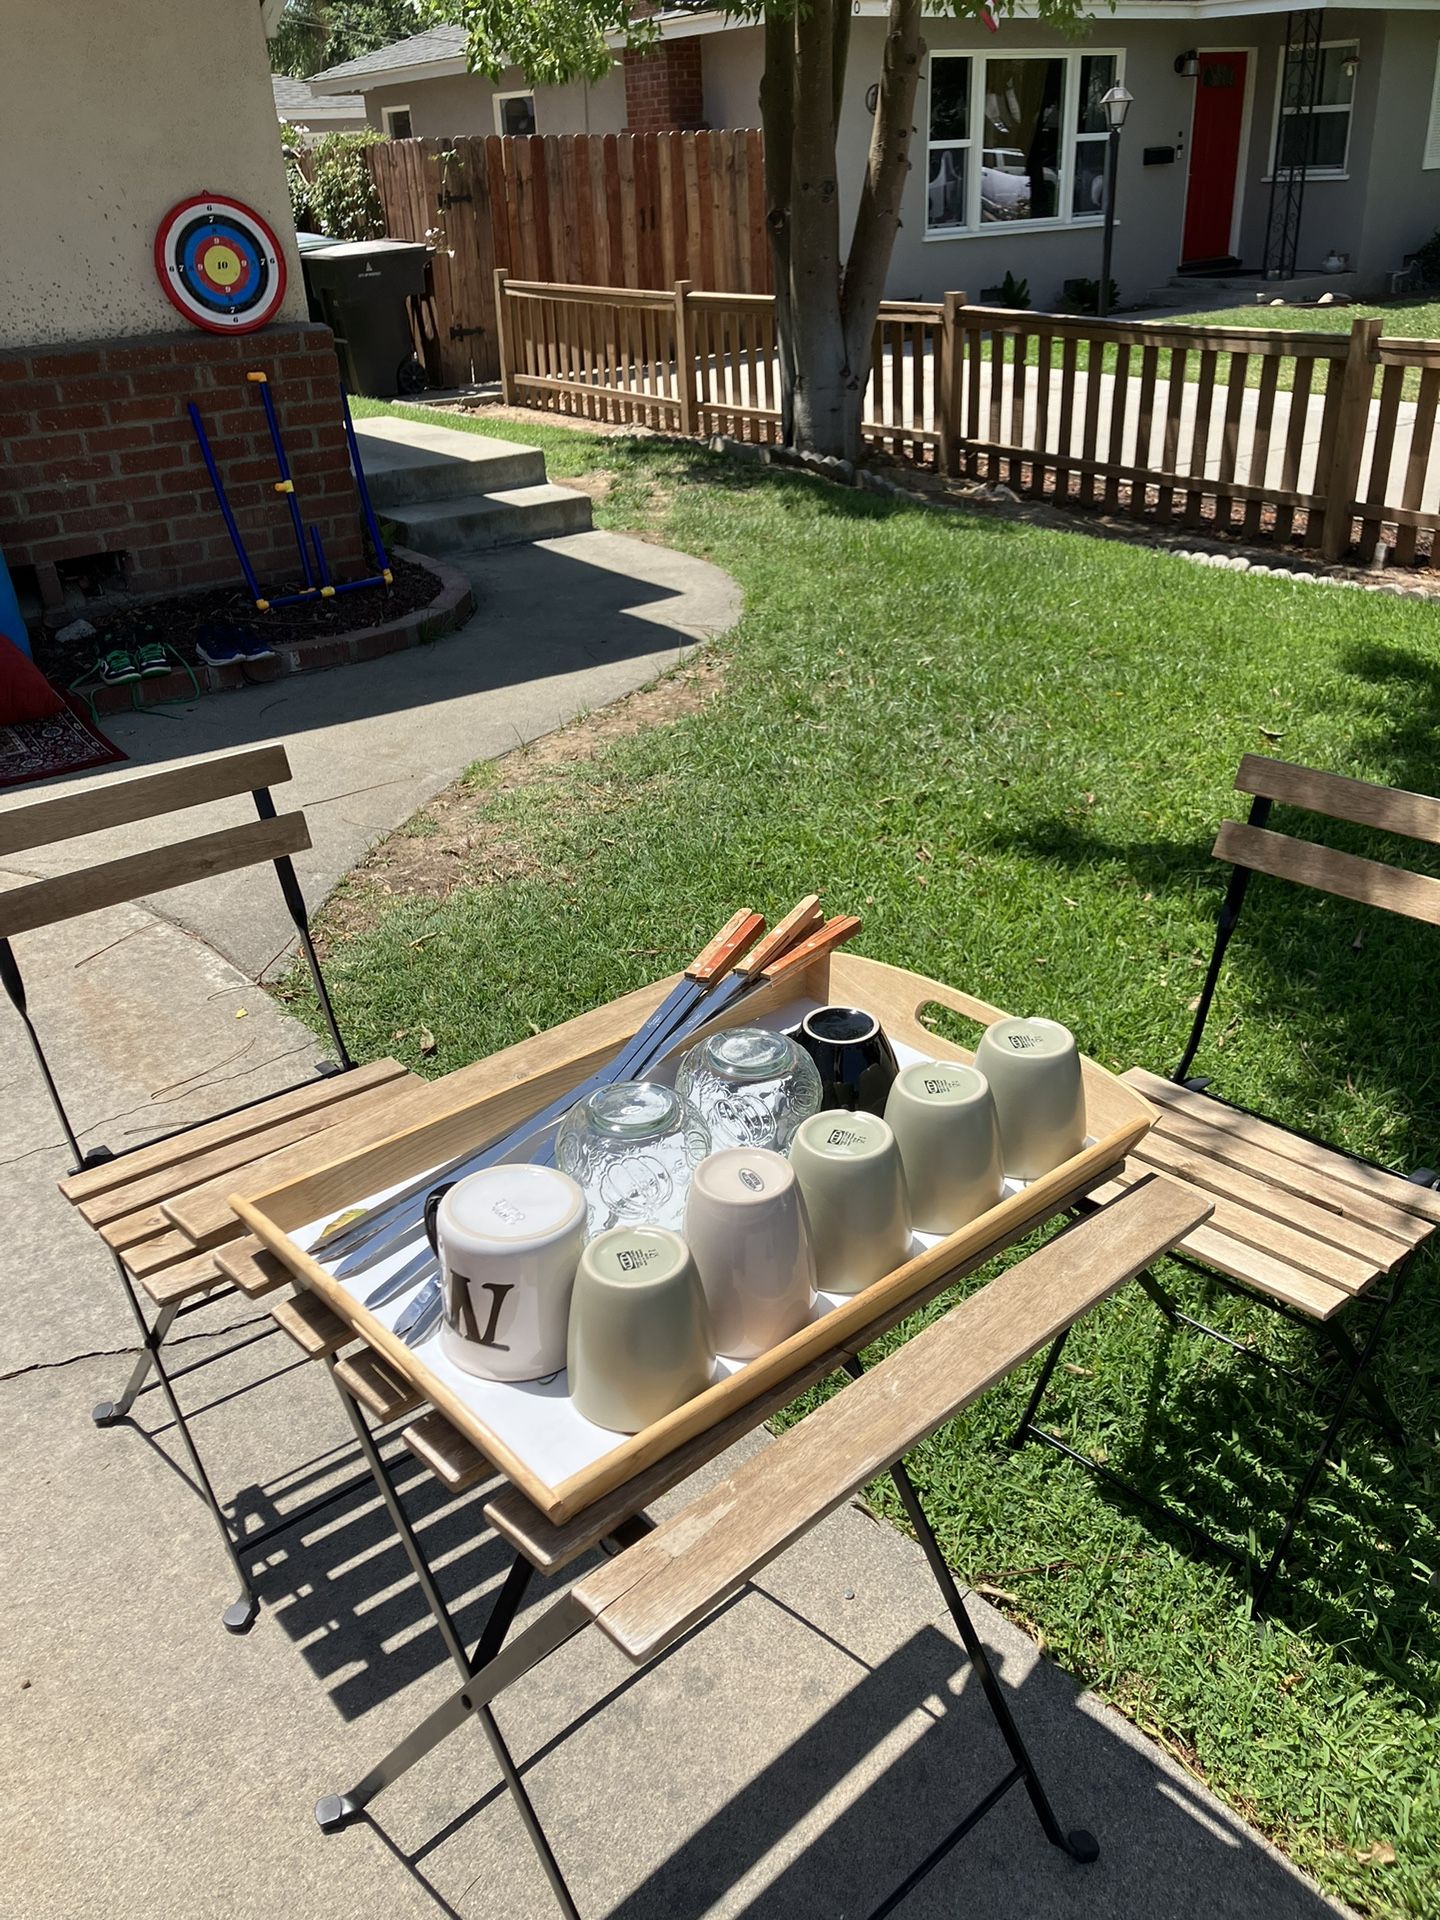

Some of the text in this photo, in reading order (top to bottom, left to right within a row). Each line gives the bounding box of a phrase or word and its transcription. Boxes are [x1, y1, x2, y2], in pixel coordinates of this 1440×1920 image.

[208, 215, 215, 223] 7
[217, 261, 228, 270] 10
[260, 258, 266, 266] 7
[178, 264, 185, 272] 7
